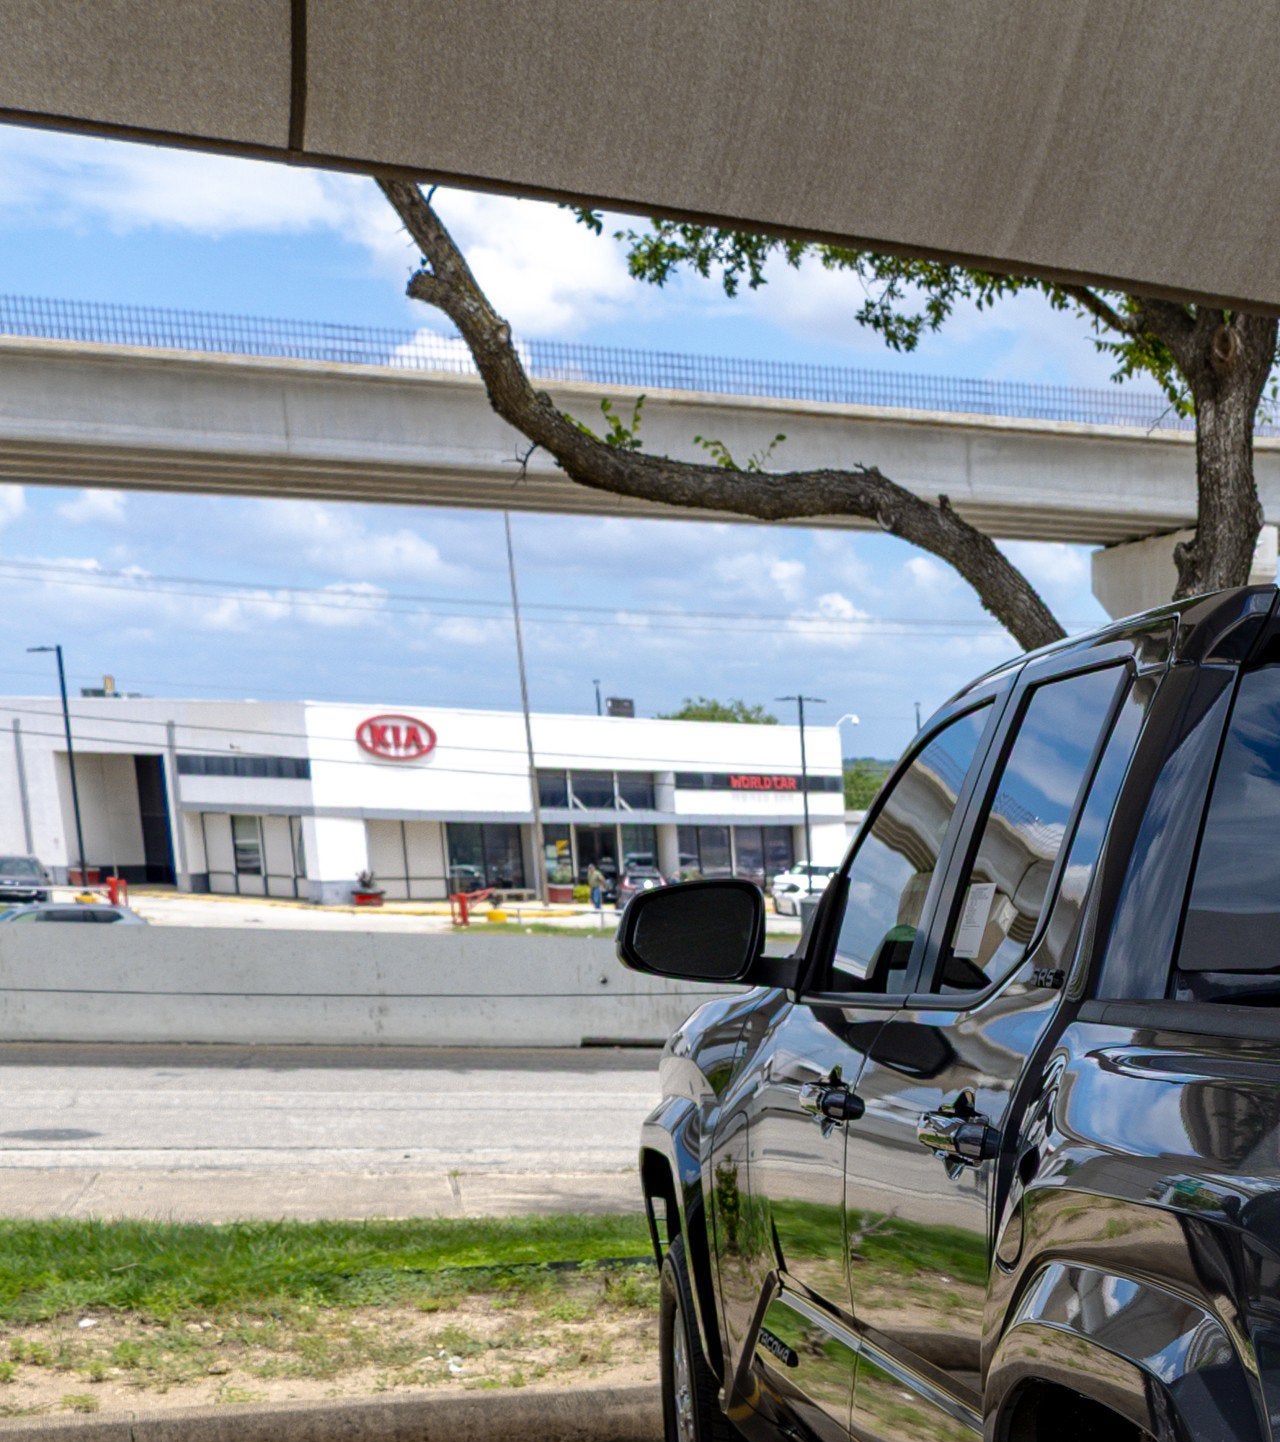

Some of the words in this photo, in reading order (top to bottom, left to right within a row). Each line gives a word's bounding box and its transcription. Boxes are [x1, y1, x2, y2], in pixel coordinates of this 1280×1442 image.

[369, 724, 424, 752] KIA
[730, 774, 772, 789] WORLD
[774, 775, 797, 790] CAR
